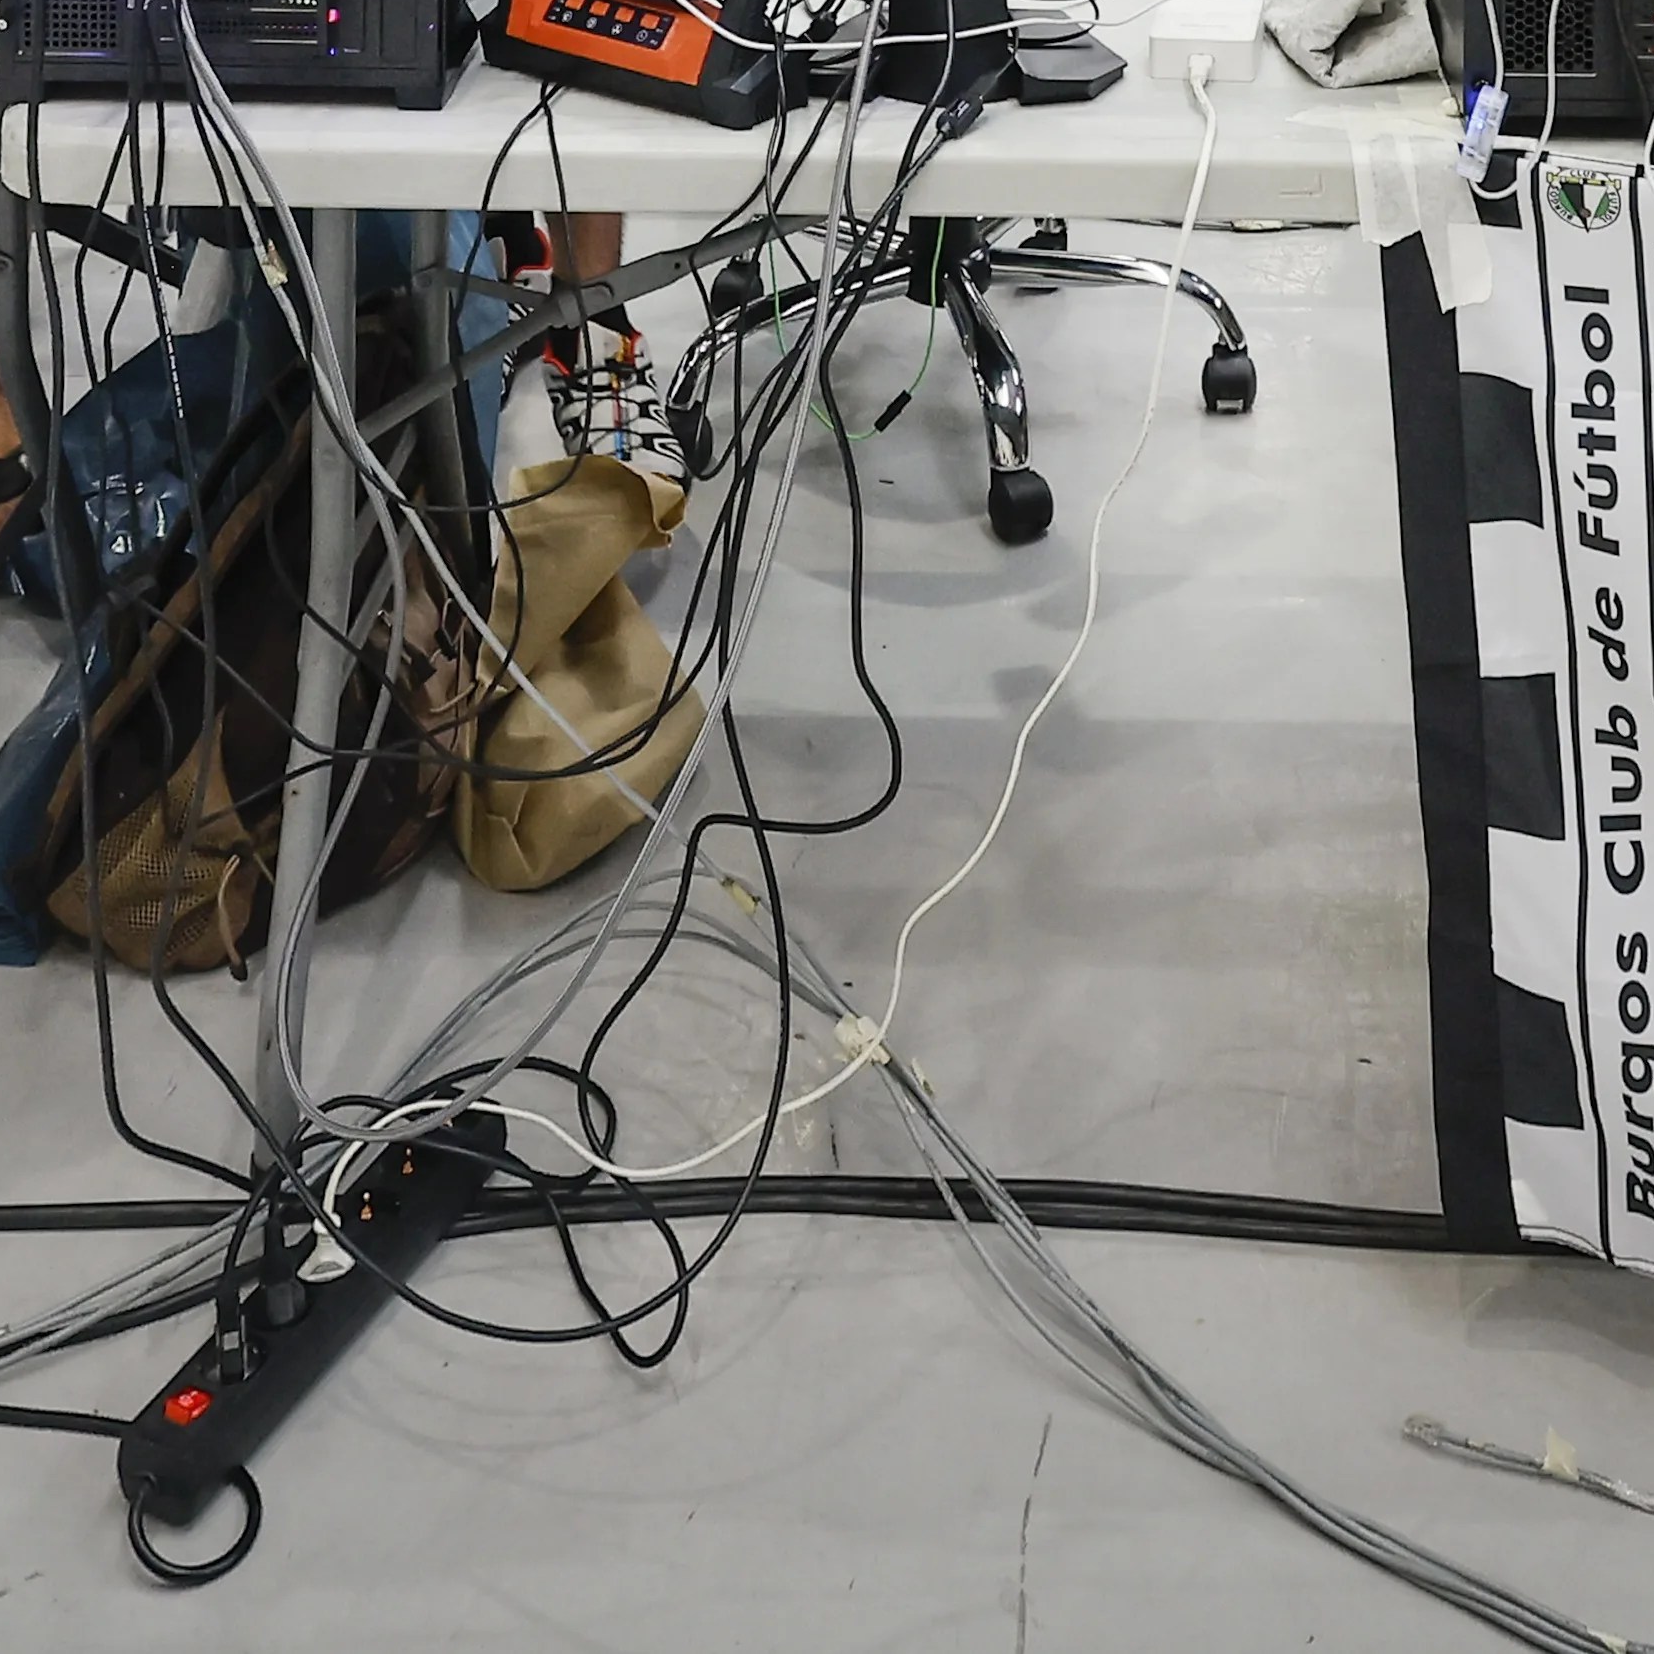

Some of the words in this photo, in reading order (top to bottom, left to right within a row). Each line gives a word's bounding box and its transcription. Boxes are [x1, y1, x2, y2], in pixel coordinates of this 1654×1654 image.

[1562, 284, 1623, 555] Fútbol
[1588, 583, 1628, 672] de
[1587, 705, 1643, 894] Club
